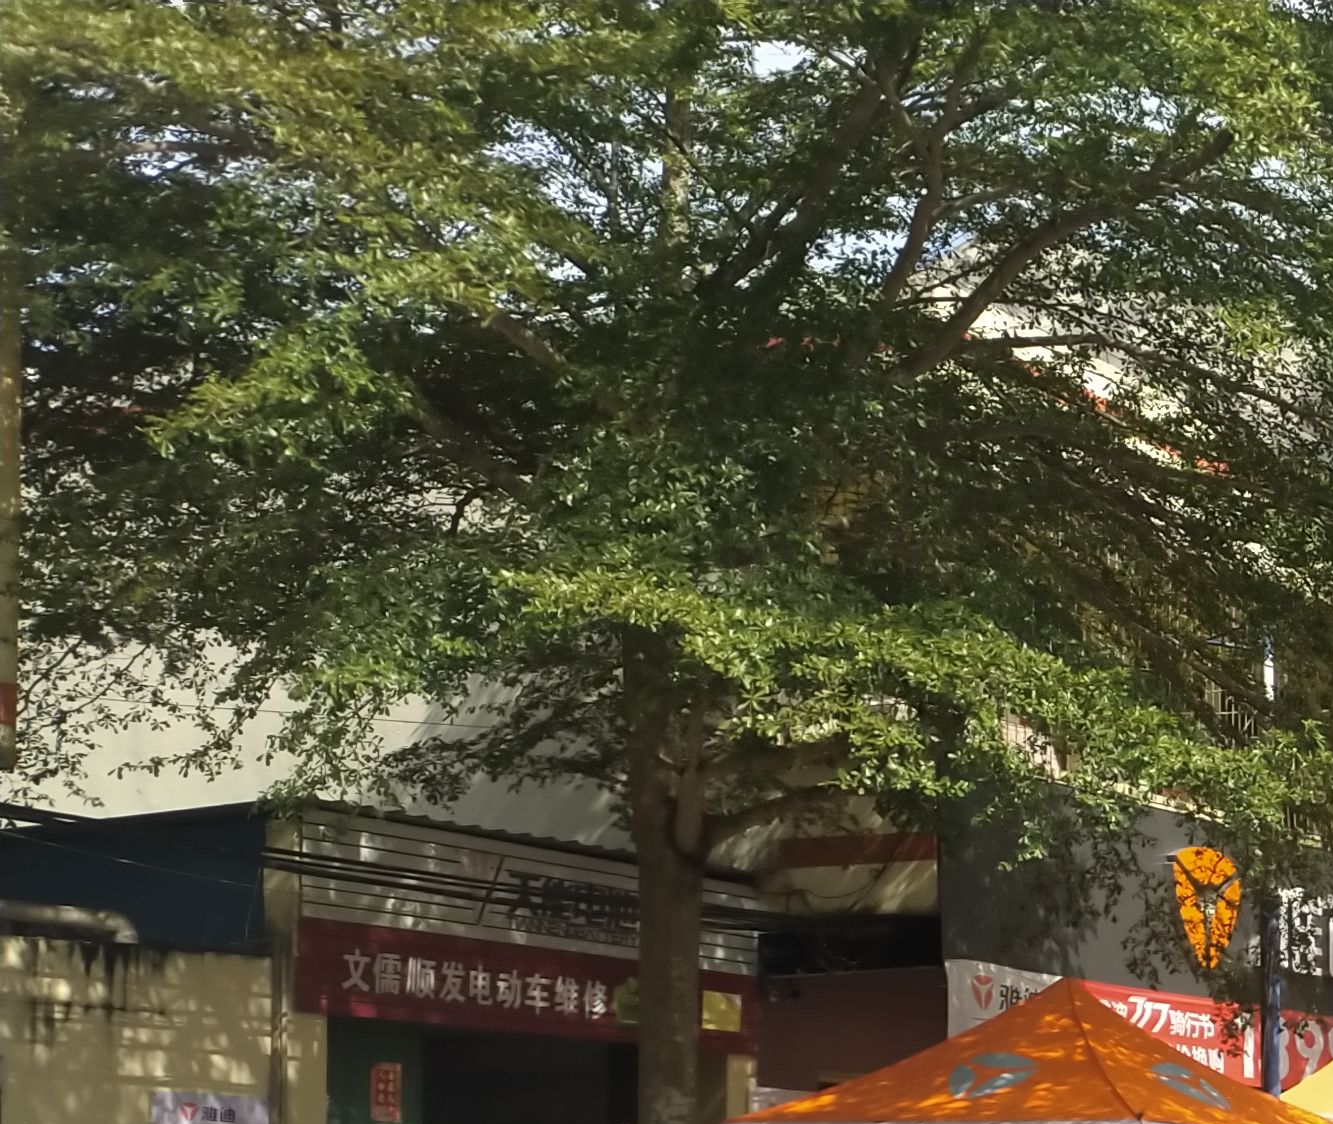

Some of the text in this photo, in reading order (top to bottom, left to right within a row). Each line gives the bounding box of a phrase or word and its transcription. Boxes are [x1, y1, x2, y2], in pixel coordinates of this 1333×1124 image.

[341, 949, 608, 1019] 文儒顺发电动车维修
